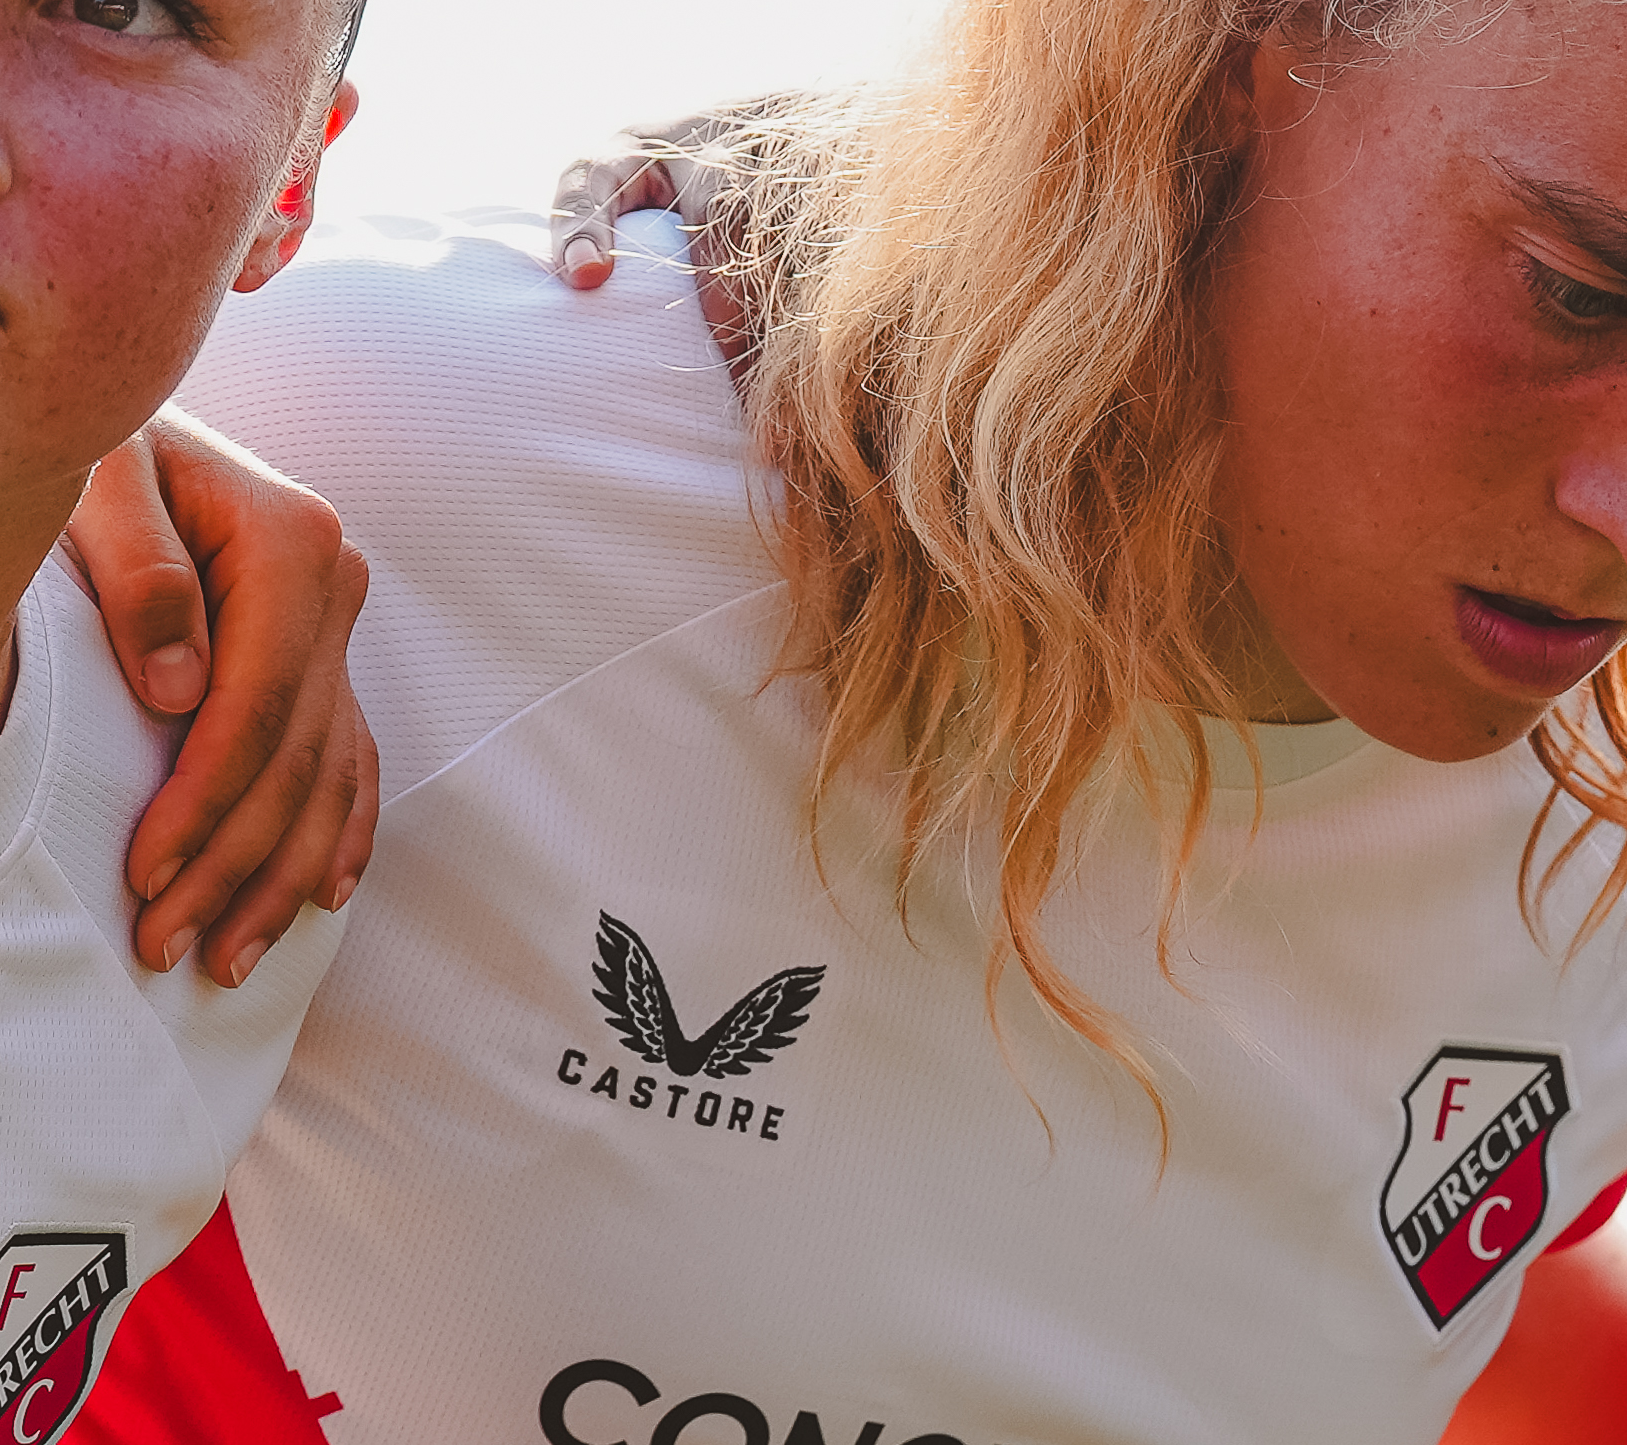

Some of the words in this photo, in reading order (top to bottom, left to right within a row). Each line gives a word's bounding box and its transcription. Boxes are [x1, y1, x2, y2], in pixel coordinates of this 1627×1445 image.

[558, 1049, 784, 1140] CASTORE
[1433, 1077, 1471, 1141] F
[1395, 1072, 1555, 1267] UTRECHT
[1468, 1196, 1512, 1261] C
[13, 1378, 55, 1445] C
